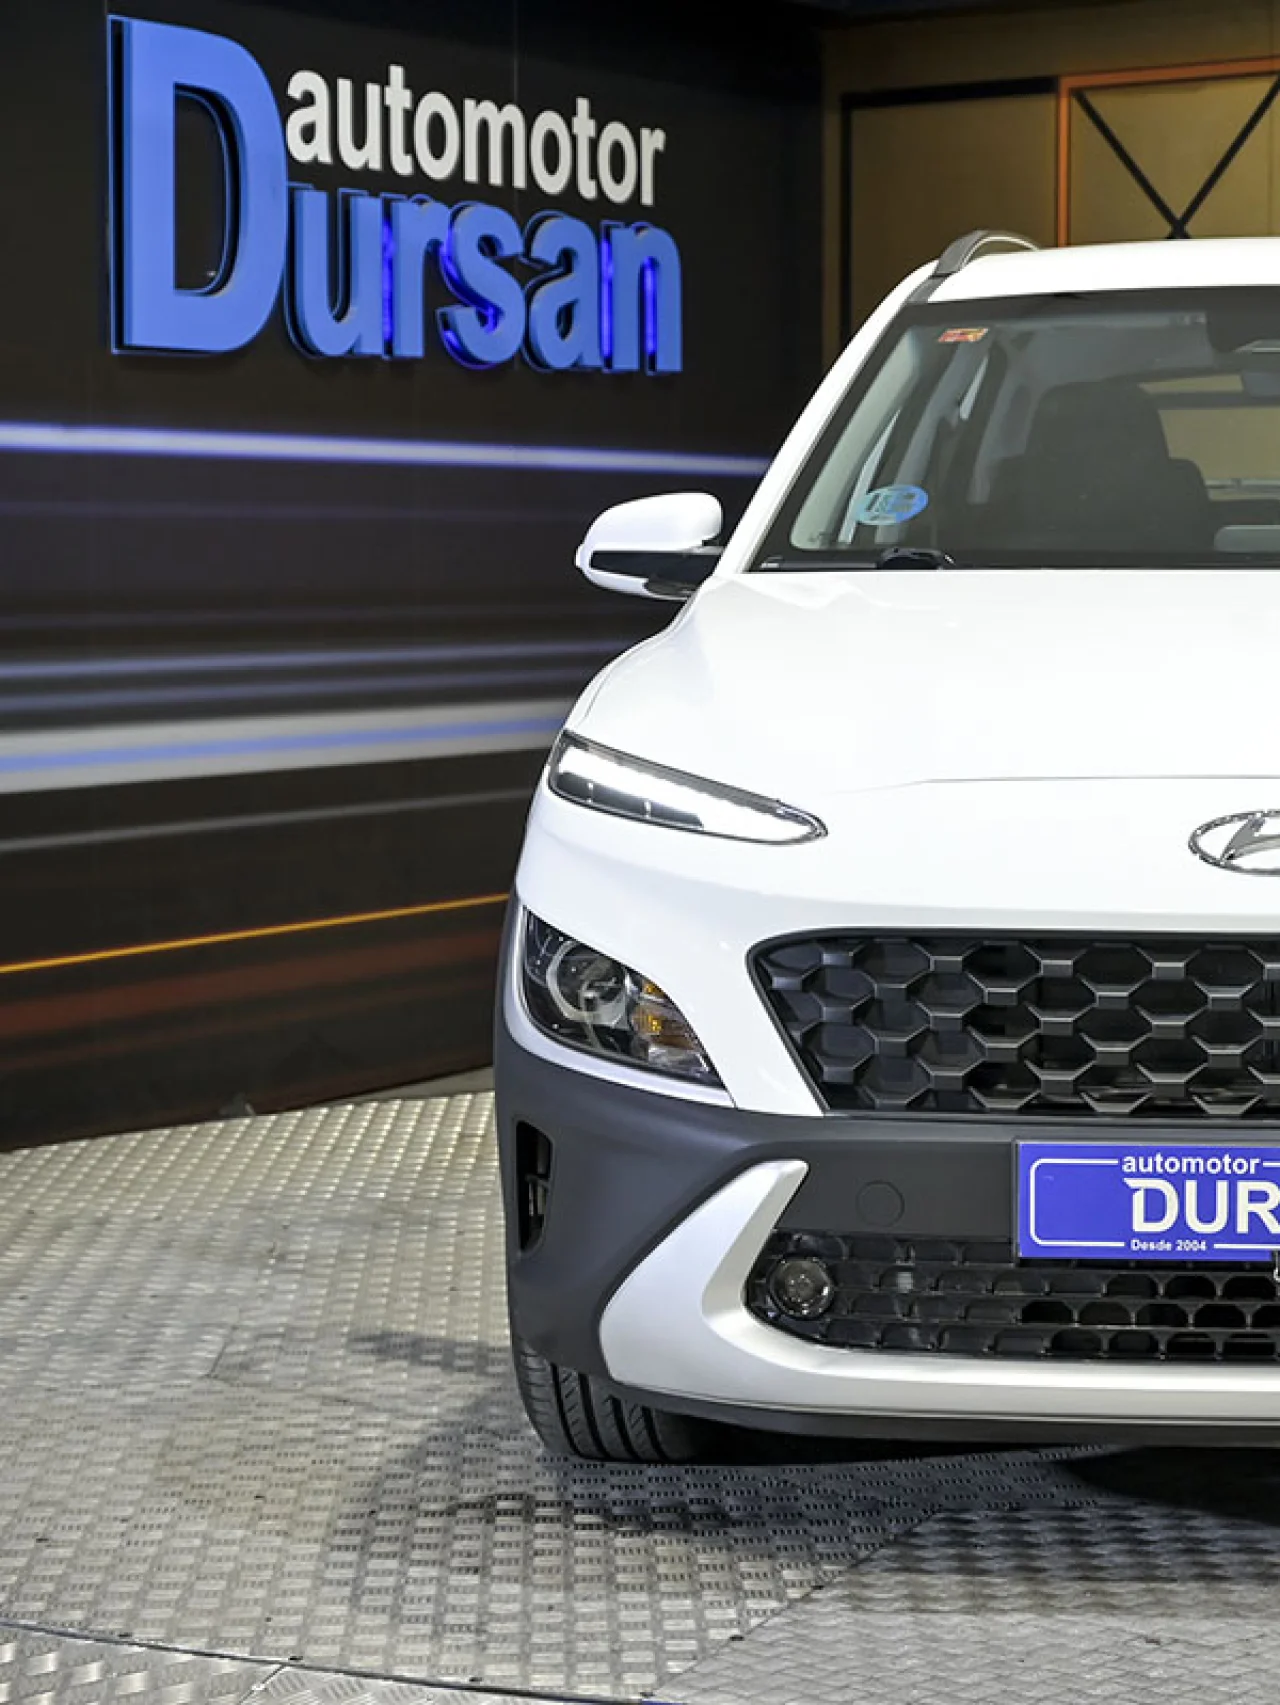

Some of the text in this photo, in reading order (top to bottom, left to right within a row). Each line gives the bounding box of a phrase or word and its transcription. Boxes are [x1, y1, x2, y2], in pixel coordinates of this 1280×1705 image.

[286, 65, 666, 206] automotor
[107, 14, 684, 374] Dursan
[1121, 1152, 1261, 1175] automotor
[1130, 1239, 1207, 1252] Desde 2004
